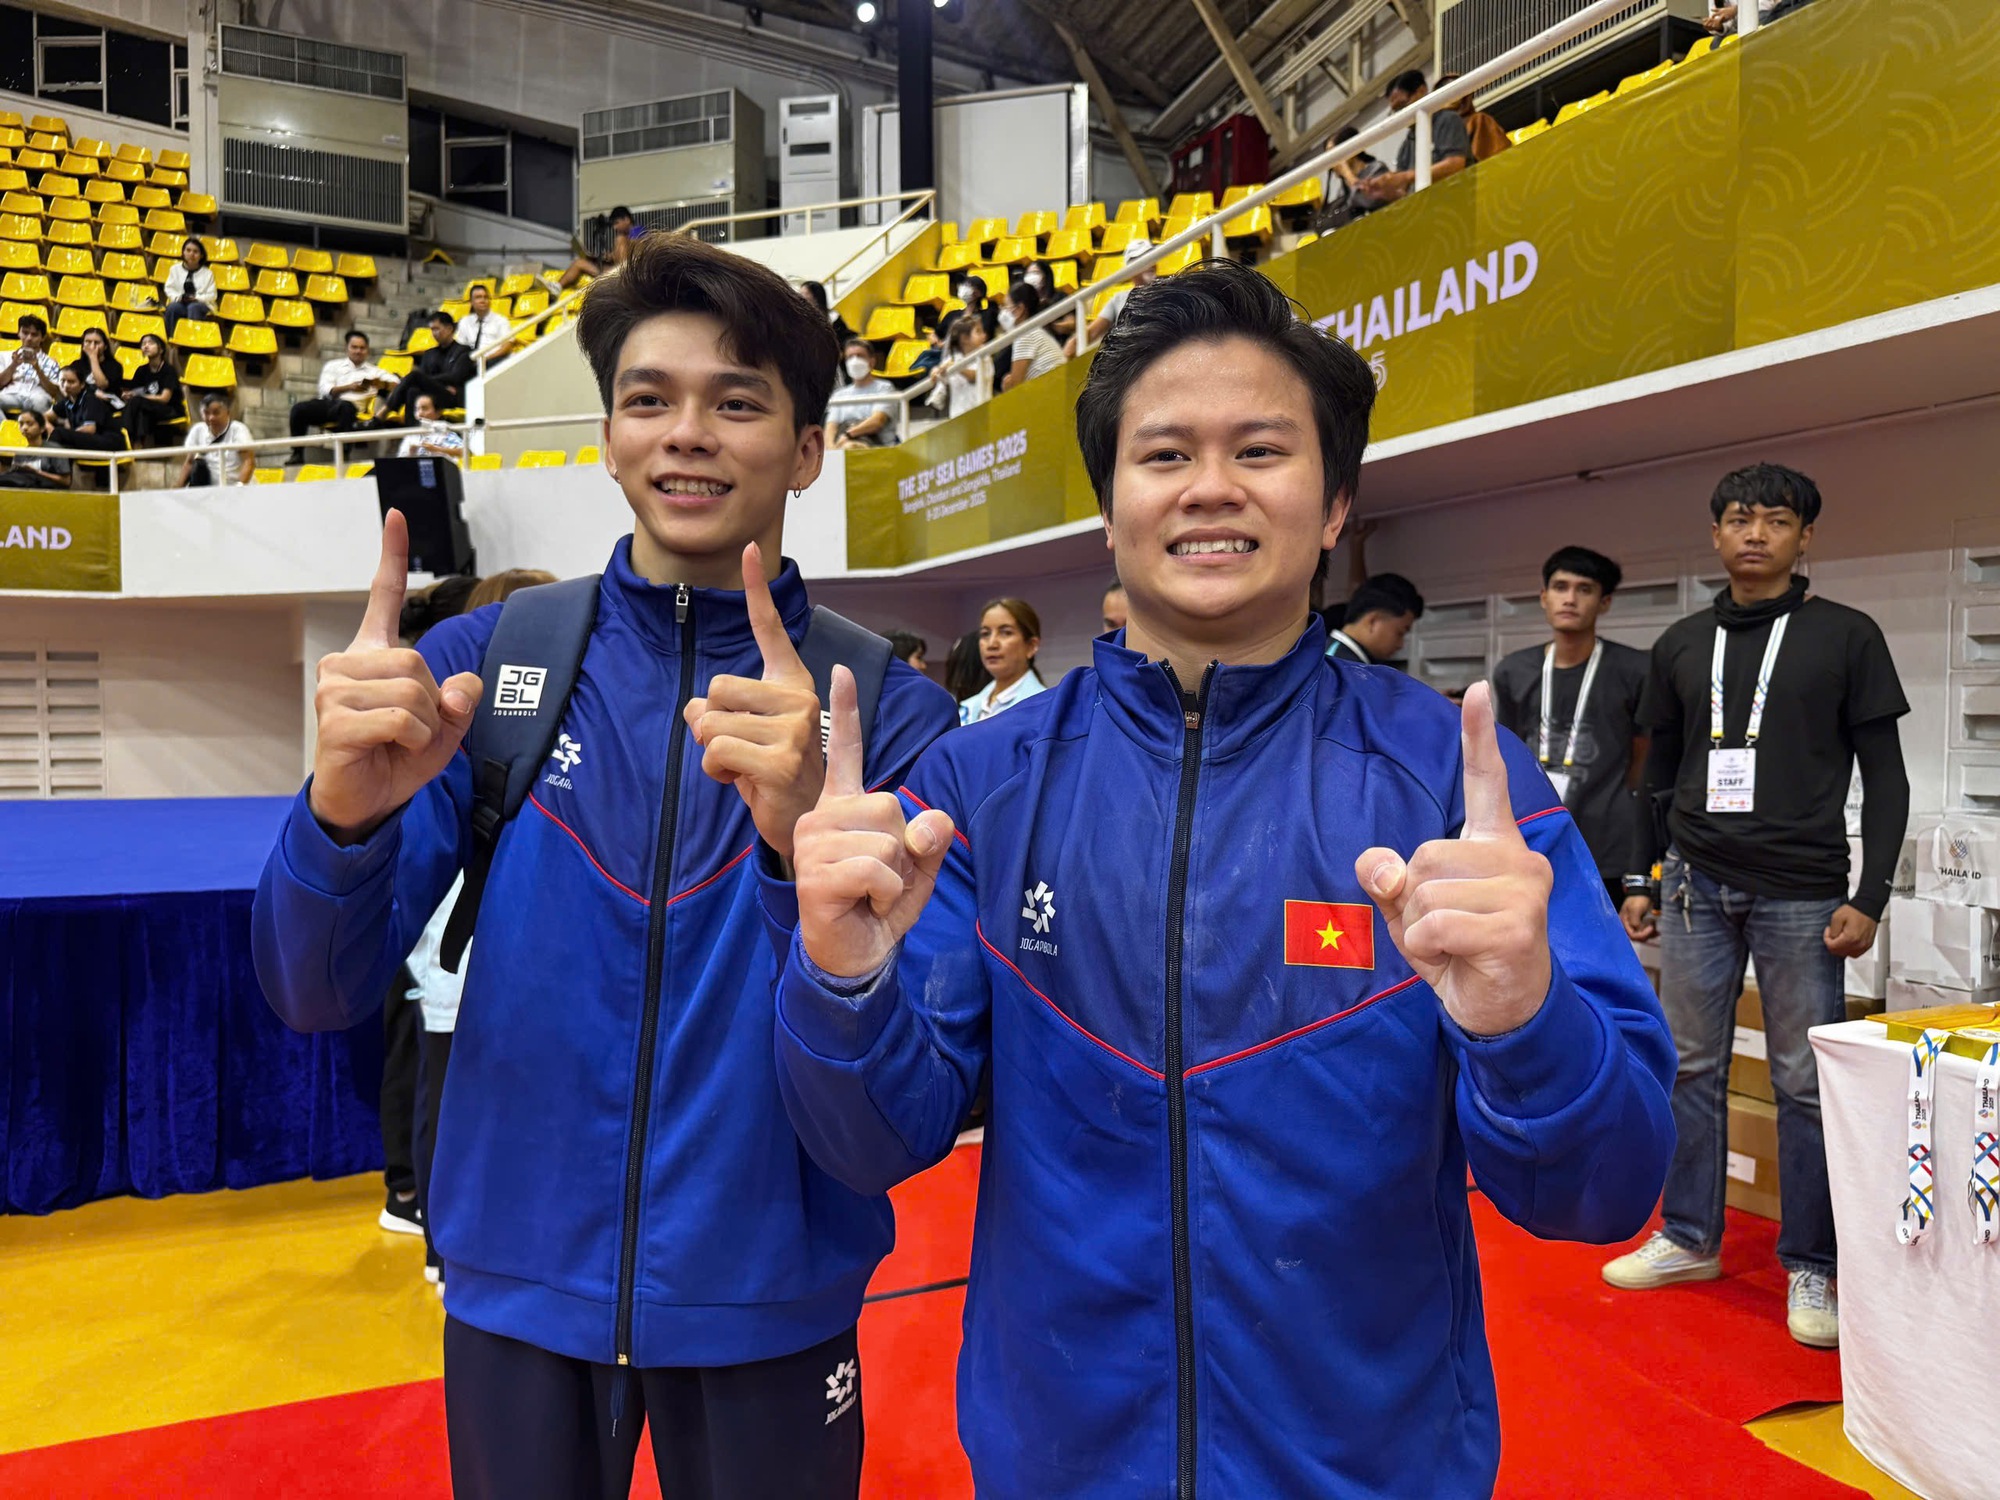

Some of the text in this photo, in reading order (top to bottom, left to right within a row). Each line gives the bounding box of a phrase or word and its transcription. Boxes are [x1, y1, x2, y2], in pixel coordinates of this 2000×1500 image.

[897, 474, 917, 501] THE
[935, 459, 956, 487] SEA
[956, 443, 995, 479] GAMES
[995, 428, 1028, 464] 2025
[991, 460, 1022, 483] Thailand
[503, 669, 541, 686] JG
[500, 688, 535, 704] BL
[1717, 778, 1744, 786] STAFF
